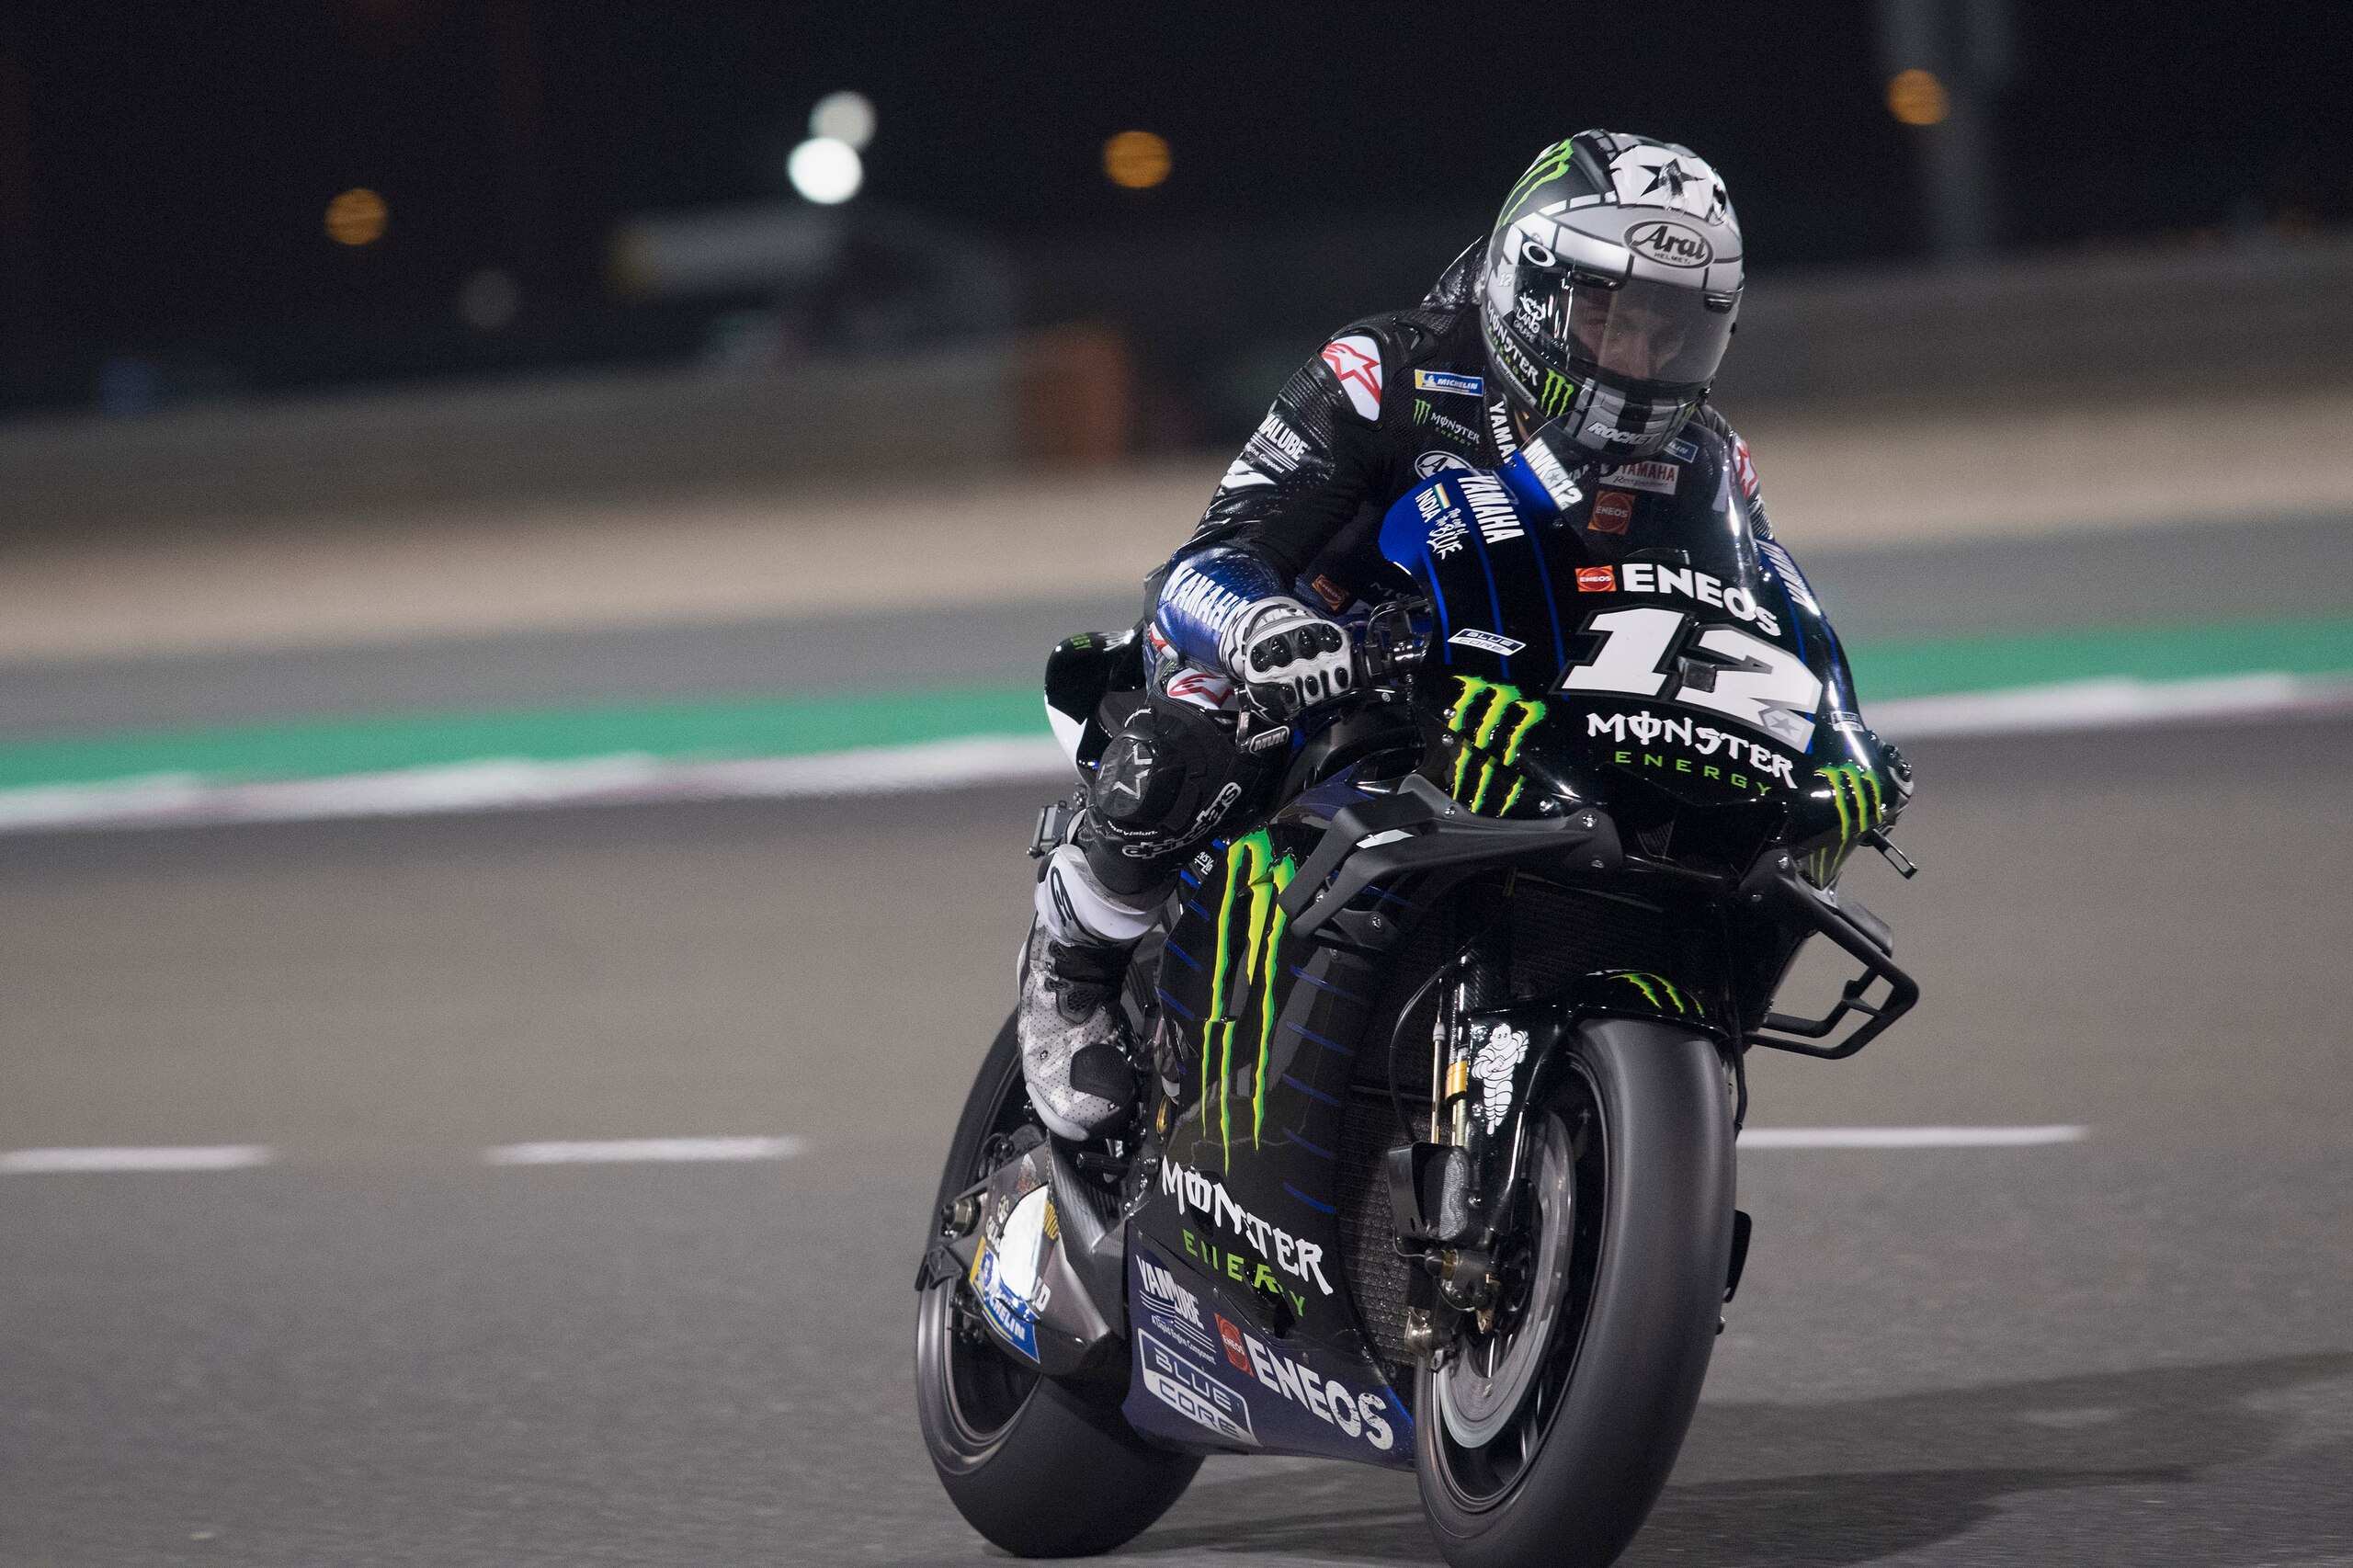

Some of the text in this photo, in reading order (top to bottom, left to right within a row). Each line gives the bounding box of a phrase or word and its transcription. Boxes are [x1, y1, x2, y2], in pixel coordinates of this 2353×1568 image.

[1631, 225, 1706, 259] Arai
[1437, 378, 1479, 390] MICHELIN
[1430, 412, 1480, 444] MONSTER
[1587, 422, 1662, 445] ROCKET
[1415, 487, 1442, 523] INDIA
[1457, 475, 1525, 544] YAMAHA
[1595, 506, 1630, 518] ENEOS
[1621, 563, 1781, 637] ENEOS
[1466, 631, 1516, 646] BLUE
[1563, 608, 1823, 755] 12
[1586, 710, 1798, 790] MONSTER
[1615, 751, 1772, 796] ENERGY
[1222, 1336, 1245, 1356] ENEOS
[1154, 1348, 1233, 1413] BLUE
[1244, 1333, 1394, 1450] ENEOS
[1159, 1378, 1239, 1437] CORE
